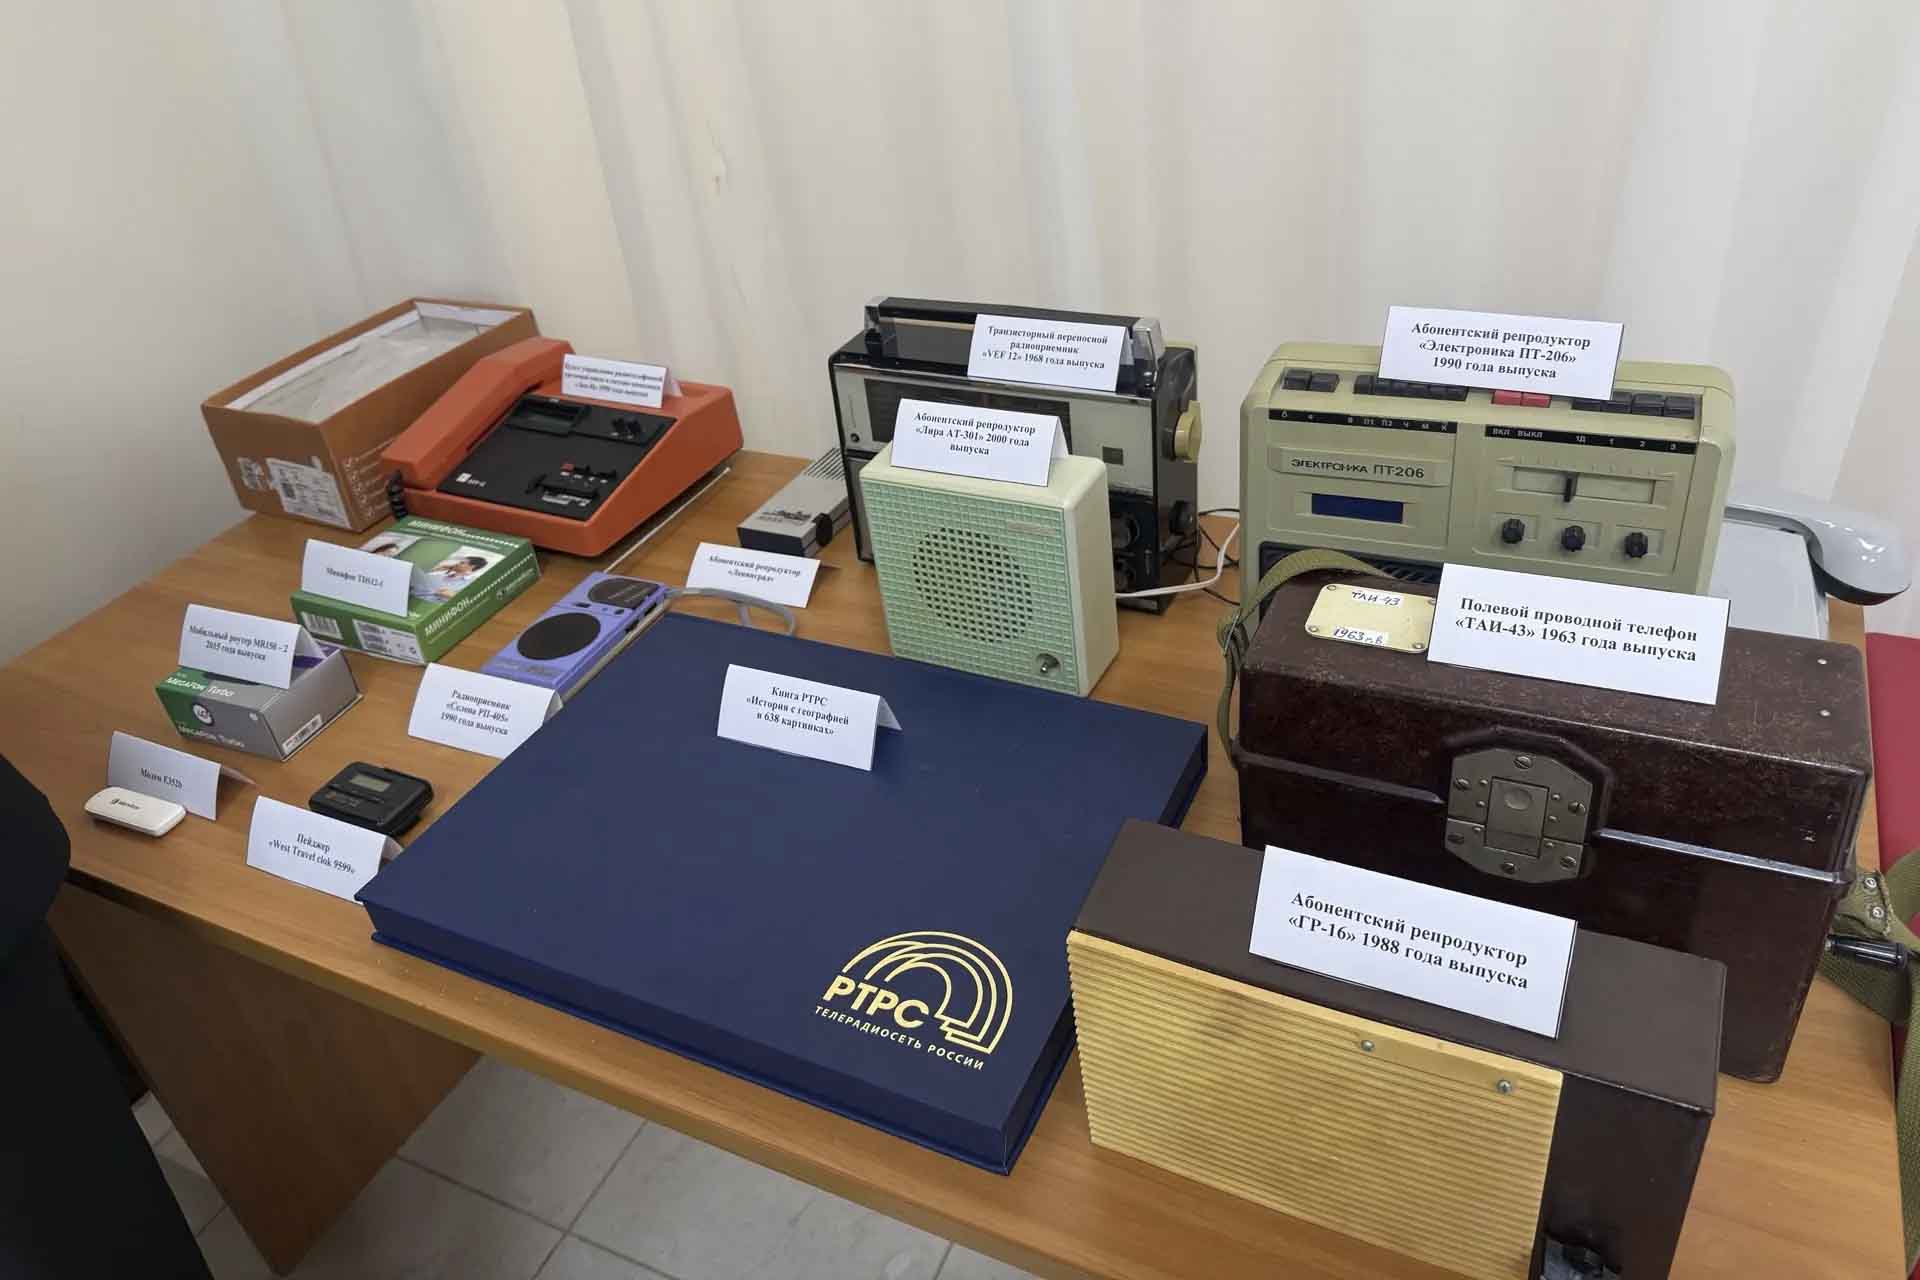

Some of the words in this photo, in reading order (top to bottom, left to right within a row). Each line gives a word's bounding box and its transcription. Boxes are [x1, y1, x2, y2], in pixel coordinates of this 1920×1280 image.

[988, 326, 1055, 340] Транзисторный
[1057, 333, 1109, 345] переносной
[1411, 322, 1500, 341] Абонентский
[1502, 331, 1592, 349] репродуктор
[1010, 341, 1080, 355] радиоприемник
[1418, 339, 1516, 358] «Электроника
[1519, 347, 1577, 364] ПТ-206»
[1024, 353, 1044, 363] 1968
[1045, 357, 1065, 366] года
[1066, 360, 1106, 371] выпуска
[1432, 356, 1463, 370] 1990
[1465, 361, 1495, 373] года
[1498, 364, 1557, 379] выпуска
[914, 411, 975, 427] Абонентский
[975, 420, 1036, 435] репродуктор
[1493, 427, 1511, 437] ВКЛ
[1517, 429, 1543, 439] ВЫКЛ
[916, 425, 945, 438] «Лира
[946, 429, 984, 441] АТ-301»
[986, 433, 1007, 444] 2000
[1009, 438, 1030, 448] года
[950, 443, 990, 456] выпуска
[1290, 458, 1368, 474] ЭЛЕКТРОНИКА
[1460, 597, 1530, 619] Полевой
[1533, 609, 1623, 632] проводной
[1626, 621, 1698, 642] телефон
[1455, 616, 1536, 638] «ТАИ-43»
[1541, 627, 1577, 645] 1963
[1581, 635, 1617, 652] года
[1622, 641, 1697, 662] выпуска
[451, 689, 512, 711] Радиоприемник
[771, 686, 800, 701] Книга
[801, 693, 829, 706] РТРС
[746, 695, 789, 713] «История
[797, 708, 849, 725] географией
[458, 717, 475, 728] года
[476, 721, 509, 736] выпуска
[764, 711, 780, 723] 638
[780, 717, 834, 735] картинках»
[292, 845, 316, 862] Travel
[296, 832, 331, 852] Пейджер
[1291, 891, 1407, 934] Абонентский
[1409, 924, 1528, 968] репродуктор
[1288, 914, 1356, 942] «ГР-16»
[1361, 932, 1401, 955] 1988
[1404, 946, 1443, 967] года
[1447, 957, 1529, 990] выпуска
[822, 974, 930, 1029] РТРС
[815, 1005, 922, 1050] ТЕЛЕРАДИОСЕТЬ
[927, 1044, 985, 1071] РОССИИ
